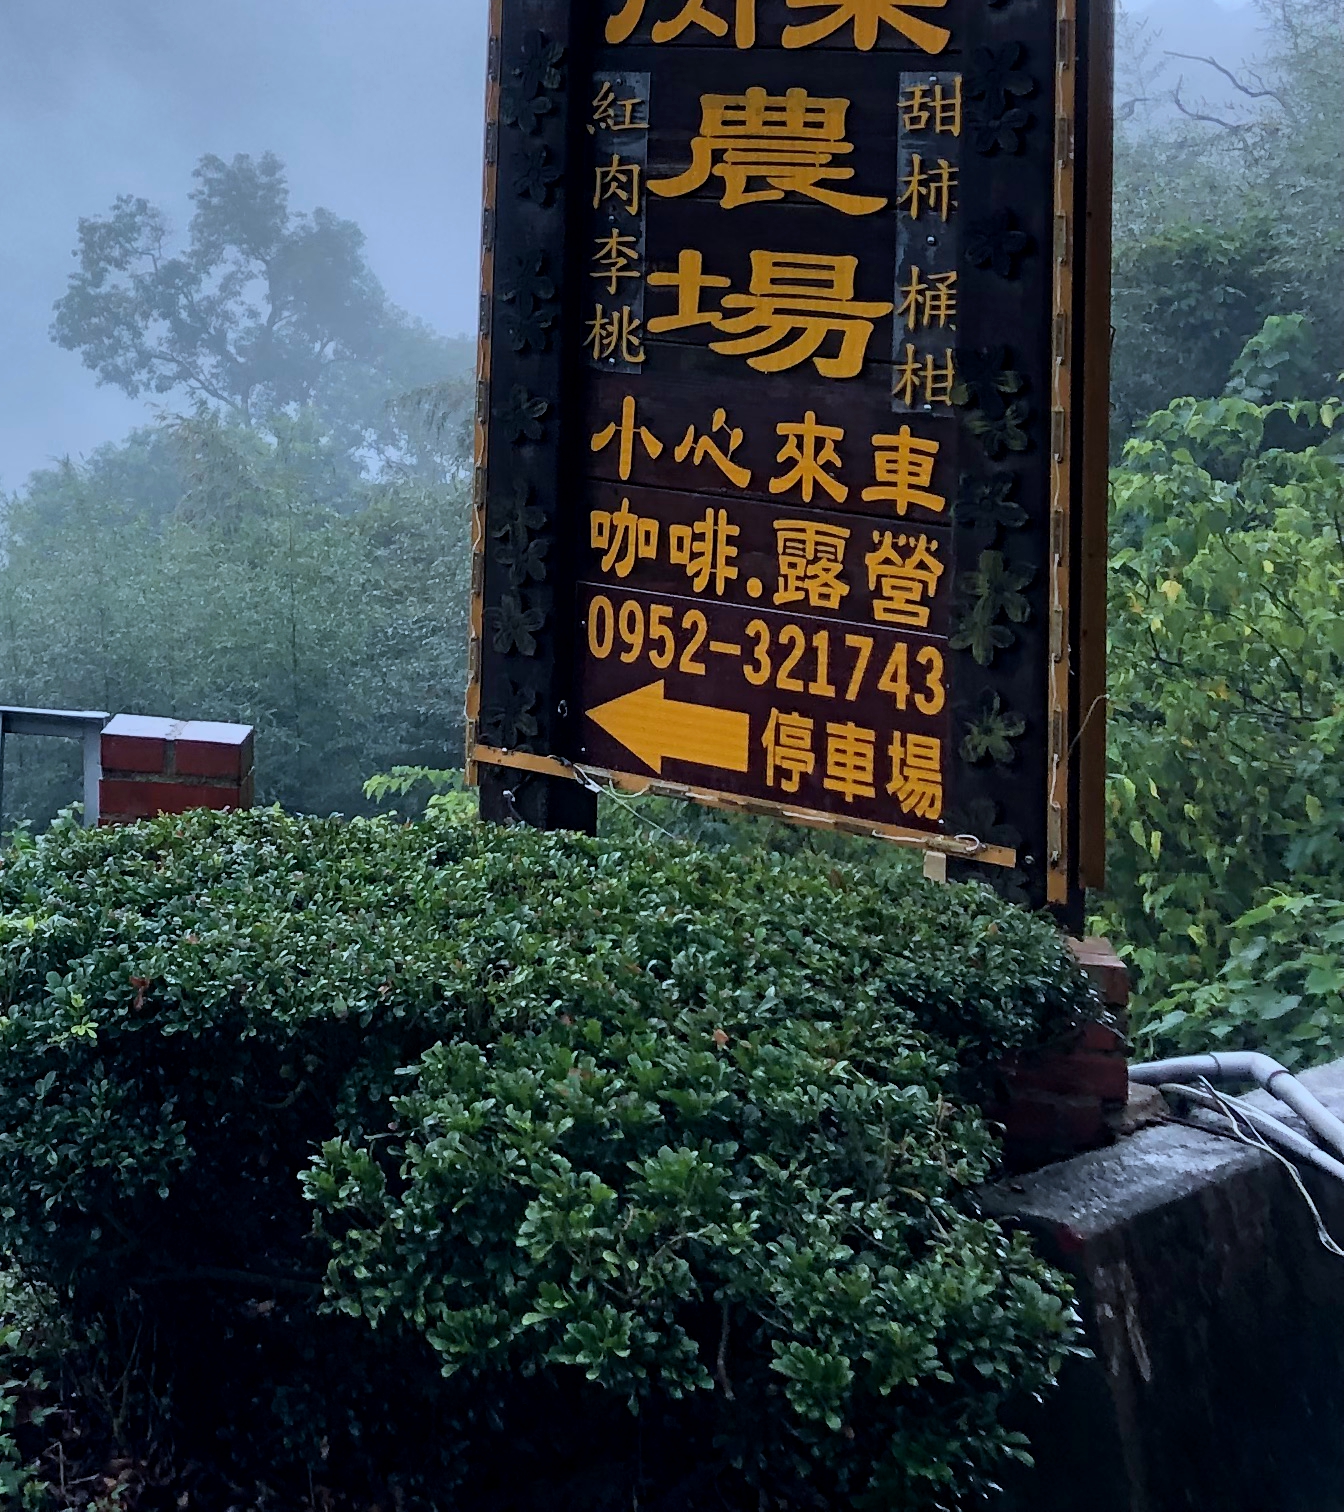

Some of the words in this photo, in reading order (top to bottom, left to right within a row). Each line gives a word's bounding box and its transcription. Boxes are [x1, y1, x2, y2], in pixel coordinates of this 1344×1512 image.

[582, 80, 651, 364] 紅肉李桃
[646, 85, 895, 379] 農場
[590, 394, 947, 516] 小心來車
[587, 595, 948, 716] 0952-321743
[761, 707, 944, 821] 停車場
